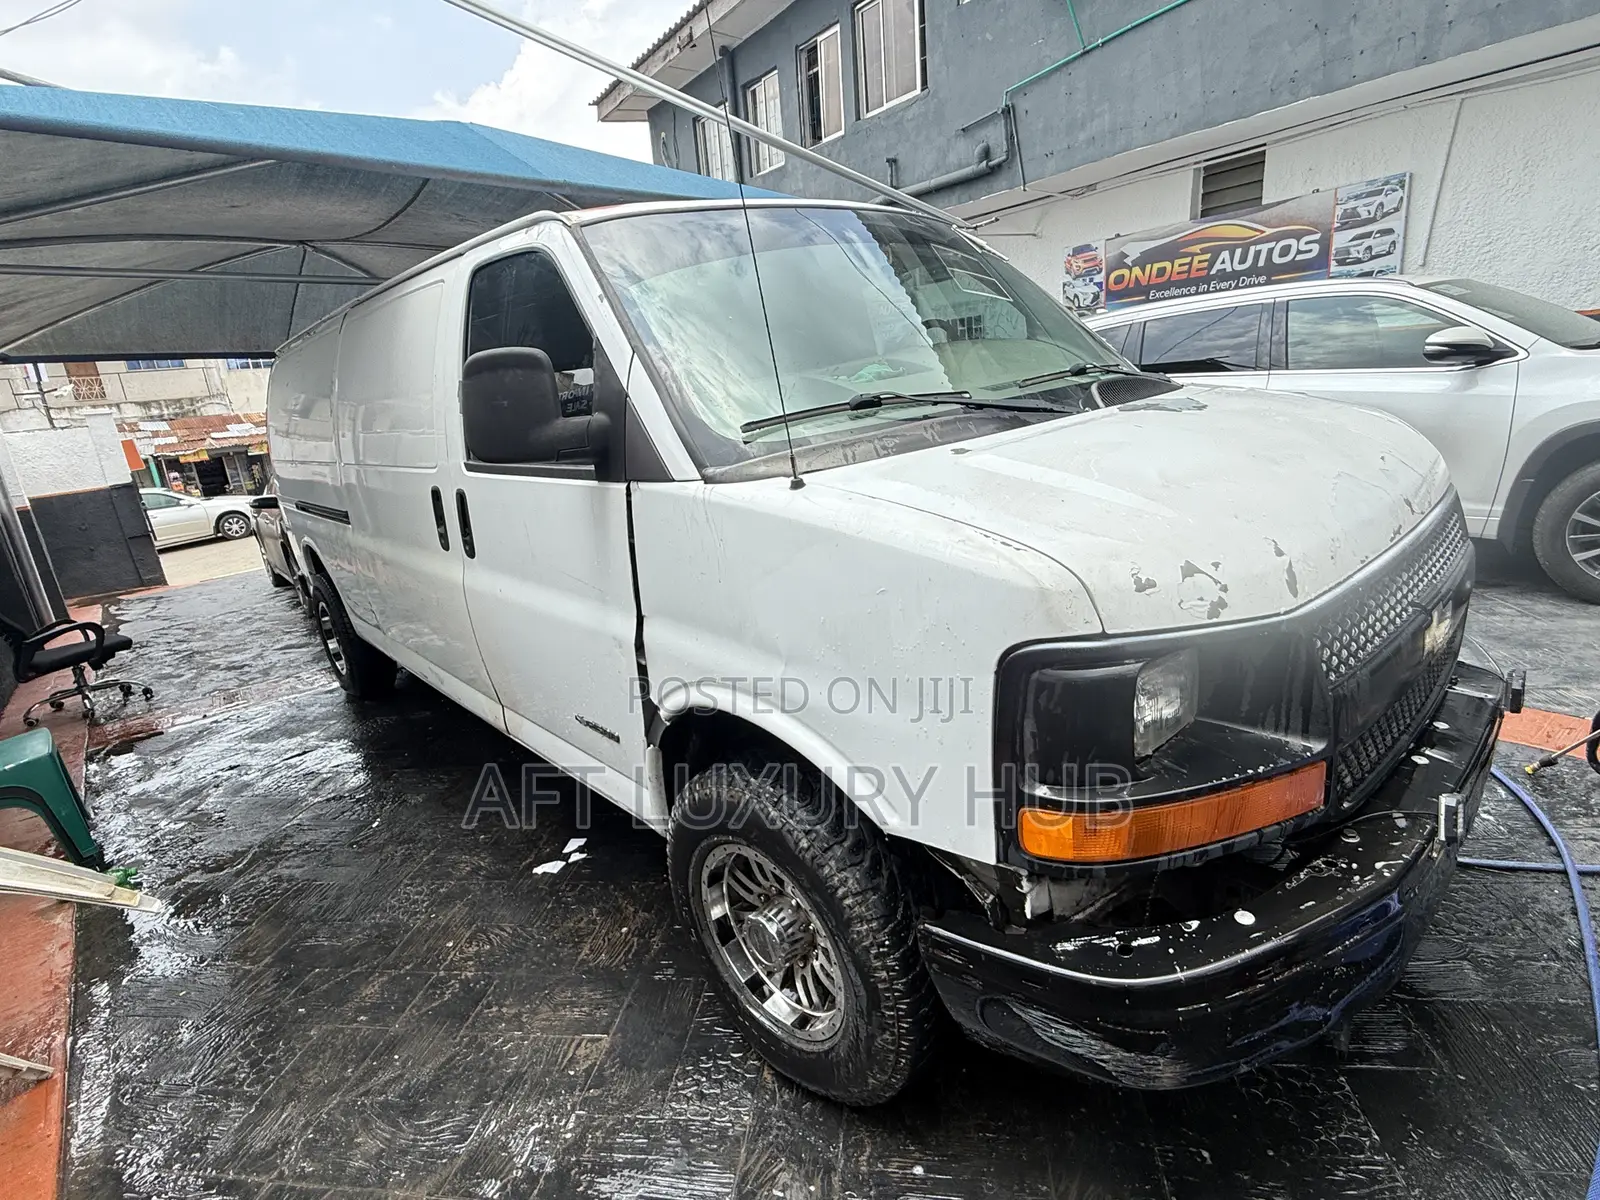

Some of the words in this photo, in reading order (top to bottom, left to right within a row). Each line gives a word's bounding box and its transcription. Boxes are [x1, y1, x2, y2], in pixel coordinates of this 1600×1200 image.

[1149, 286, 1197, 300] Excellence
[1198, 282, 1207, 293] in
[1209, 279, 1238, 291] Every
[1238, 275, 1267, 287] Drive
